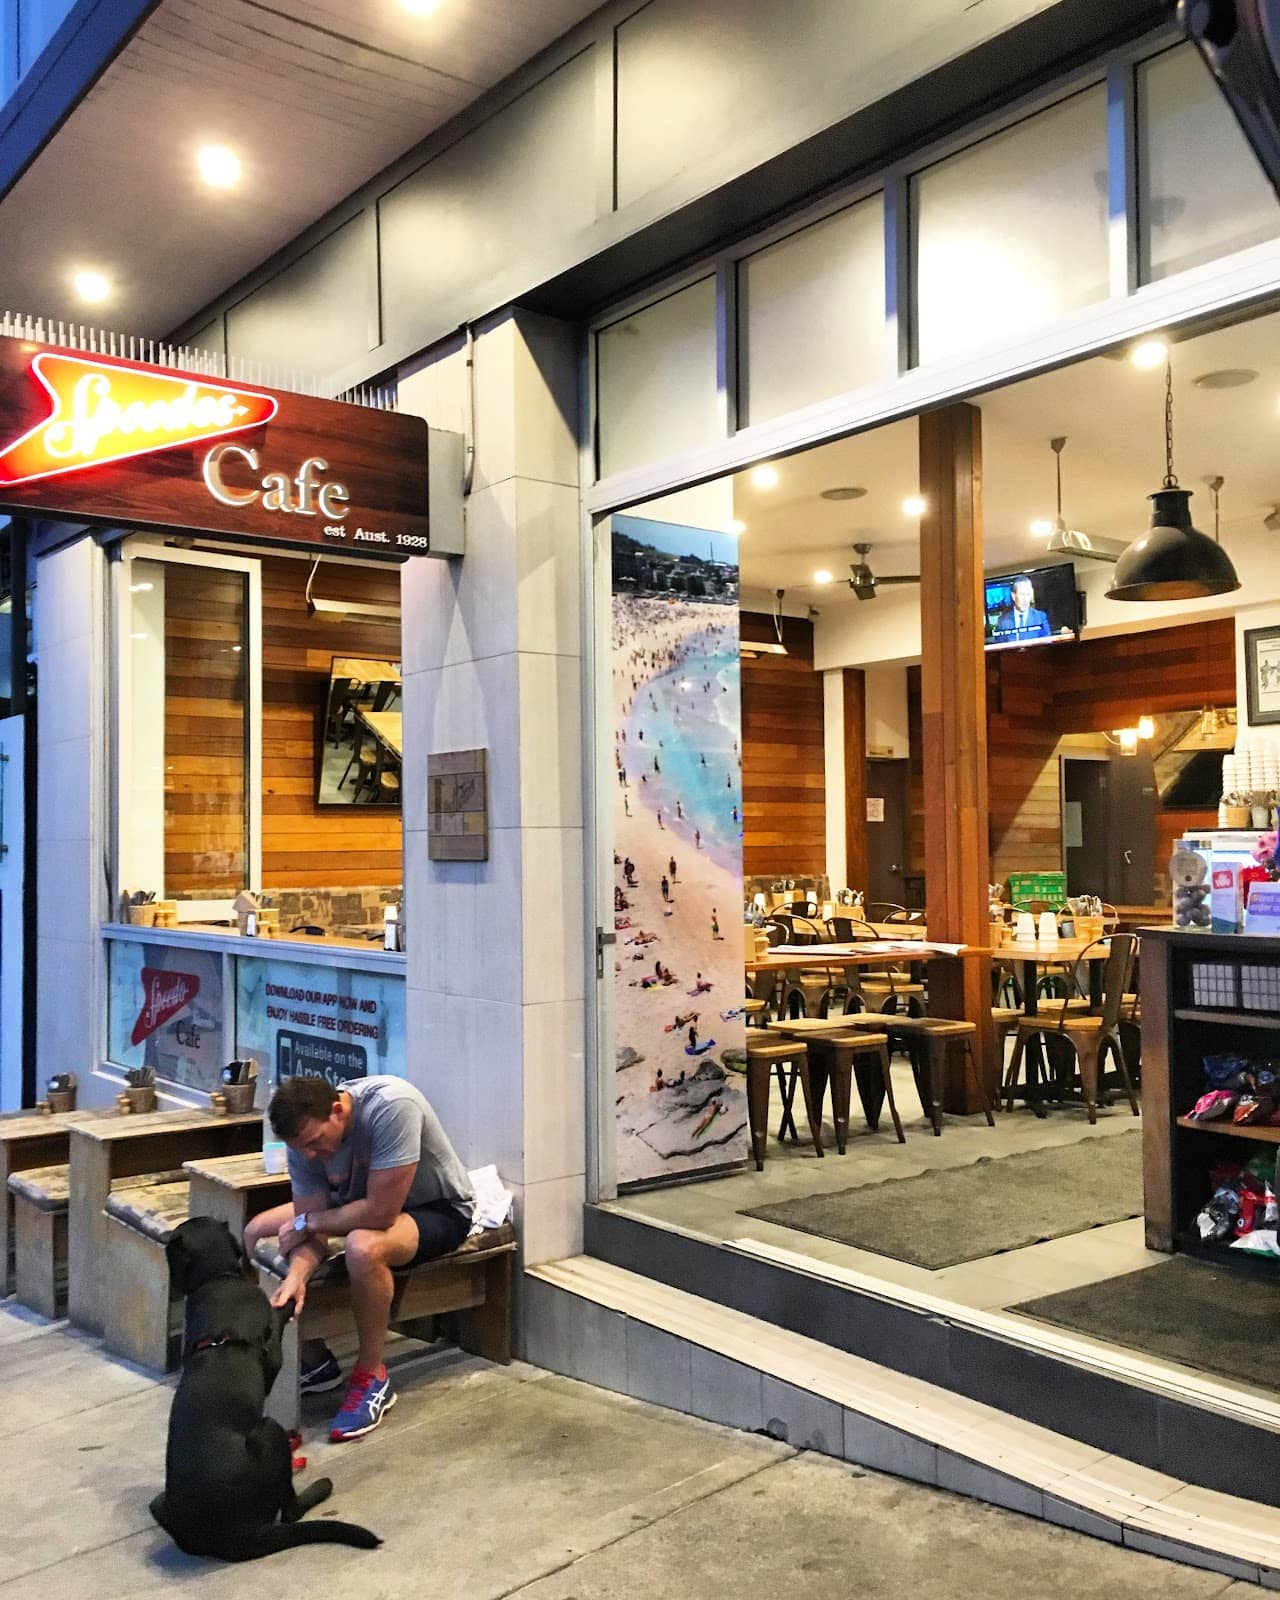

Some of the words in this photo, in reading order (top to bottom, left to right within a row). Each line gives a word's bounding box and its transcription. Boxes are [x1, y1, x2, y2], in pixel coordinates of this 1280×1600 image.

[202, 441, 350, 520] Cafe
[323, 525, 346, 537] est
[353, 527, 391, 543] Aust.
[395, 533, 428, 548] 1928
[265, 983, 305, 1002] DOWNLOAD
[305, 990, 321, 1004] OUR
[322, 993, 338, 1007] APP
[339, 995, 357, 1011] NOW
[359, 999, 377, 1014] AND
[176, 1020, 200, 1048] Cafe
[266, 1005, 288, 1020] ENJOY
[317, 1015, 337, 1031] FREE
[337, 1019, 379, 1039] ORDERING
[294, 1040, 332, 1062] Available
[334, 1053, 346, 1065] on
[348, 1052, 363, 1070] the
